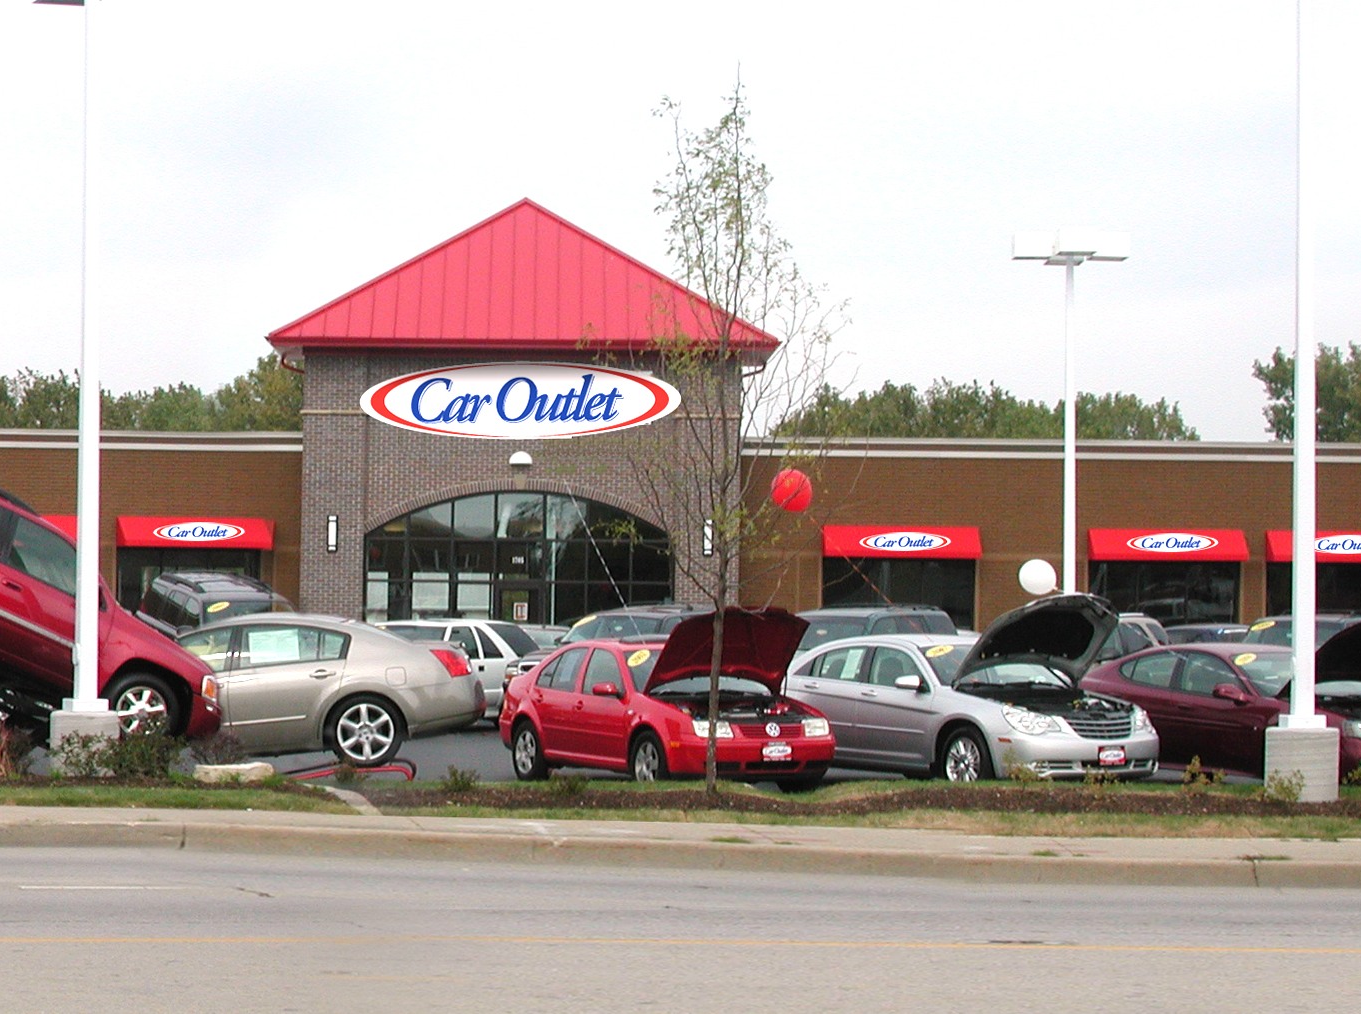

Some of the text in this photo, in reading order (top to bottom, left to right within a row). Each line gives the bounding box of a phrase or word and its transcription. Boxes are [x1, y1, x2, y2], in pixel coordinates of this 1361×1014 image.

[410, 373, 624, 424] Car Outlet
[167, 525, 228, 538] Car Outlet
[873, 535, 934, 548] Car Outlet
[1141, 536, 1202, 549] Car Outlet
[1317, 539, 1340, 551] Car
